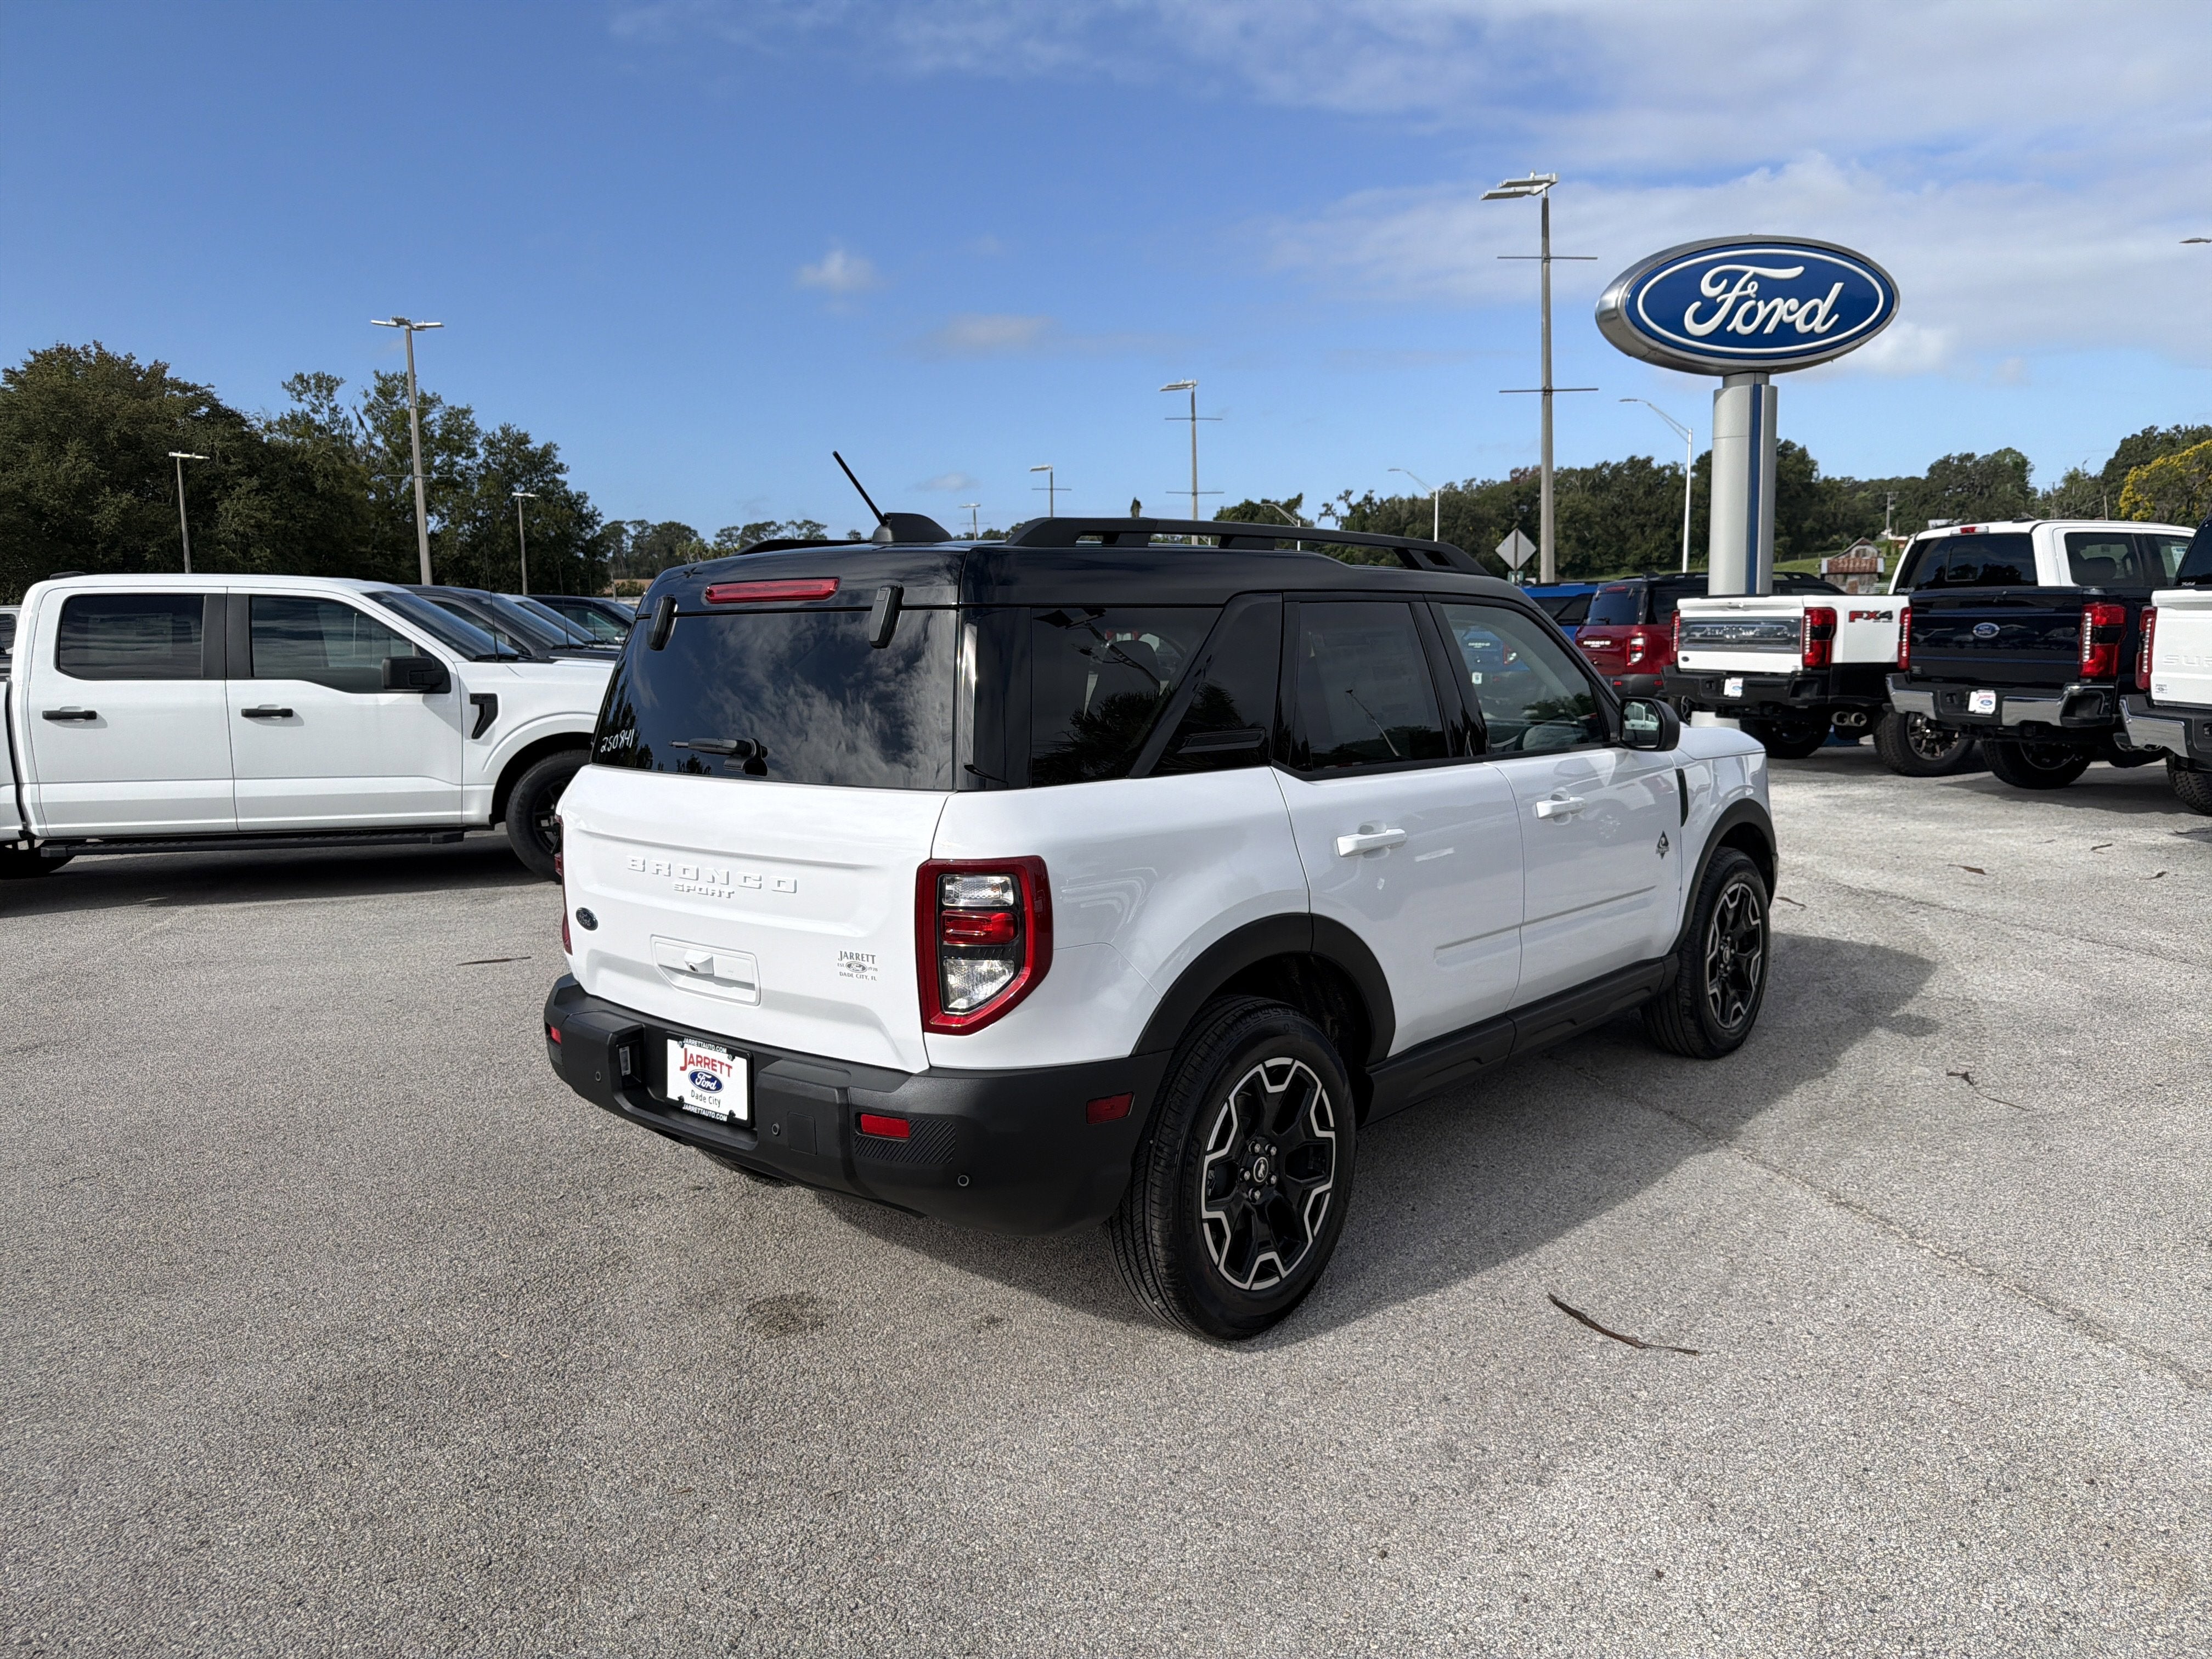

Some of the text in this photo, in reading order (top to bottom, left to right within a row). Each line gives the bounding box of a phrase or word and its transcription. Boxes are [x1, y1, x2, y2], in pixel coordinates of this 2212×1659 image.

[1684, 264, 1844, 337] Ford
[1848, 610, 1893, 623] FX4
[601, 728, 635, 753] 250841
[624, 855, 797, 894] BRONCO
[672, 882, 735, 899] SPORT
[838, 950, 876, 964] JARRETT
[682, 1037, 727, 1053] JARRETTAUTO.COM
[680, 1047, 733, 1078] JARRETT
[695, 1071, 718, 1091] Ford
[691, 1089, 721, 1108] Dade City
[682, 1103, 727, 1122] JARRETTAUTO.COM
